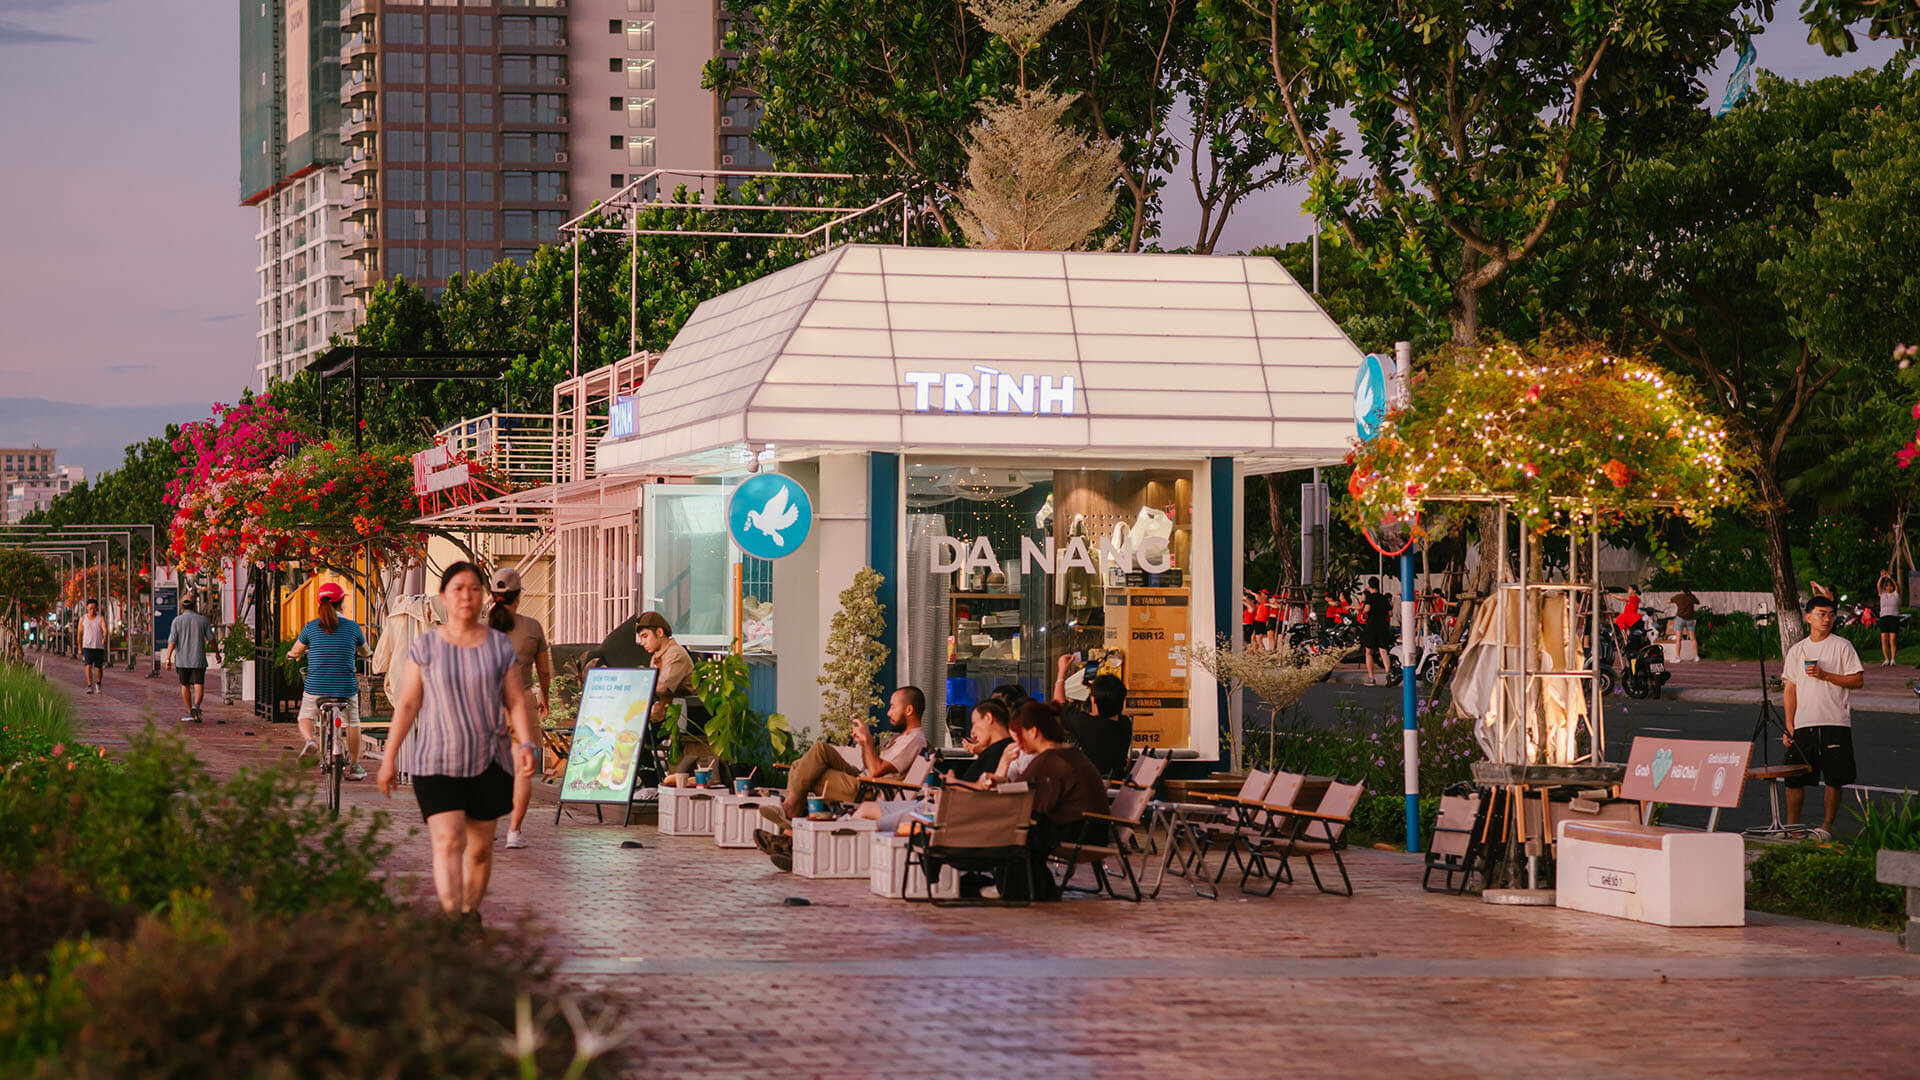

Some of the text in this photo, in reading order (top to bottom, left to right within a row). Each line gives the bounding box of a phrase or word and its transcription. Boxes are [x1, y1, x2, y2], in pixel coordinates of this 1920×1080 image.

[904, 365, 1074, 414] TRÌNH
[930, 535, 1170, 575] DA NANG
[1142, 597, 1167, 605] YAMAHA
[1132, 632, 1165, 640] DBR12
[1133, 734, 1160, 742] BR12
[1635, 764, 1650, 777] Grab
